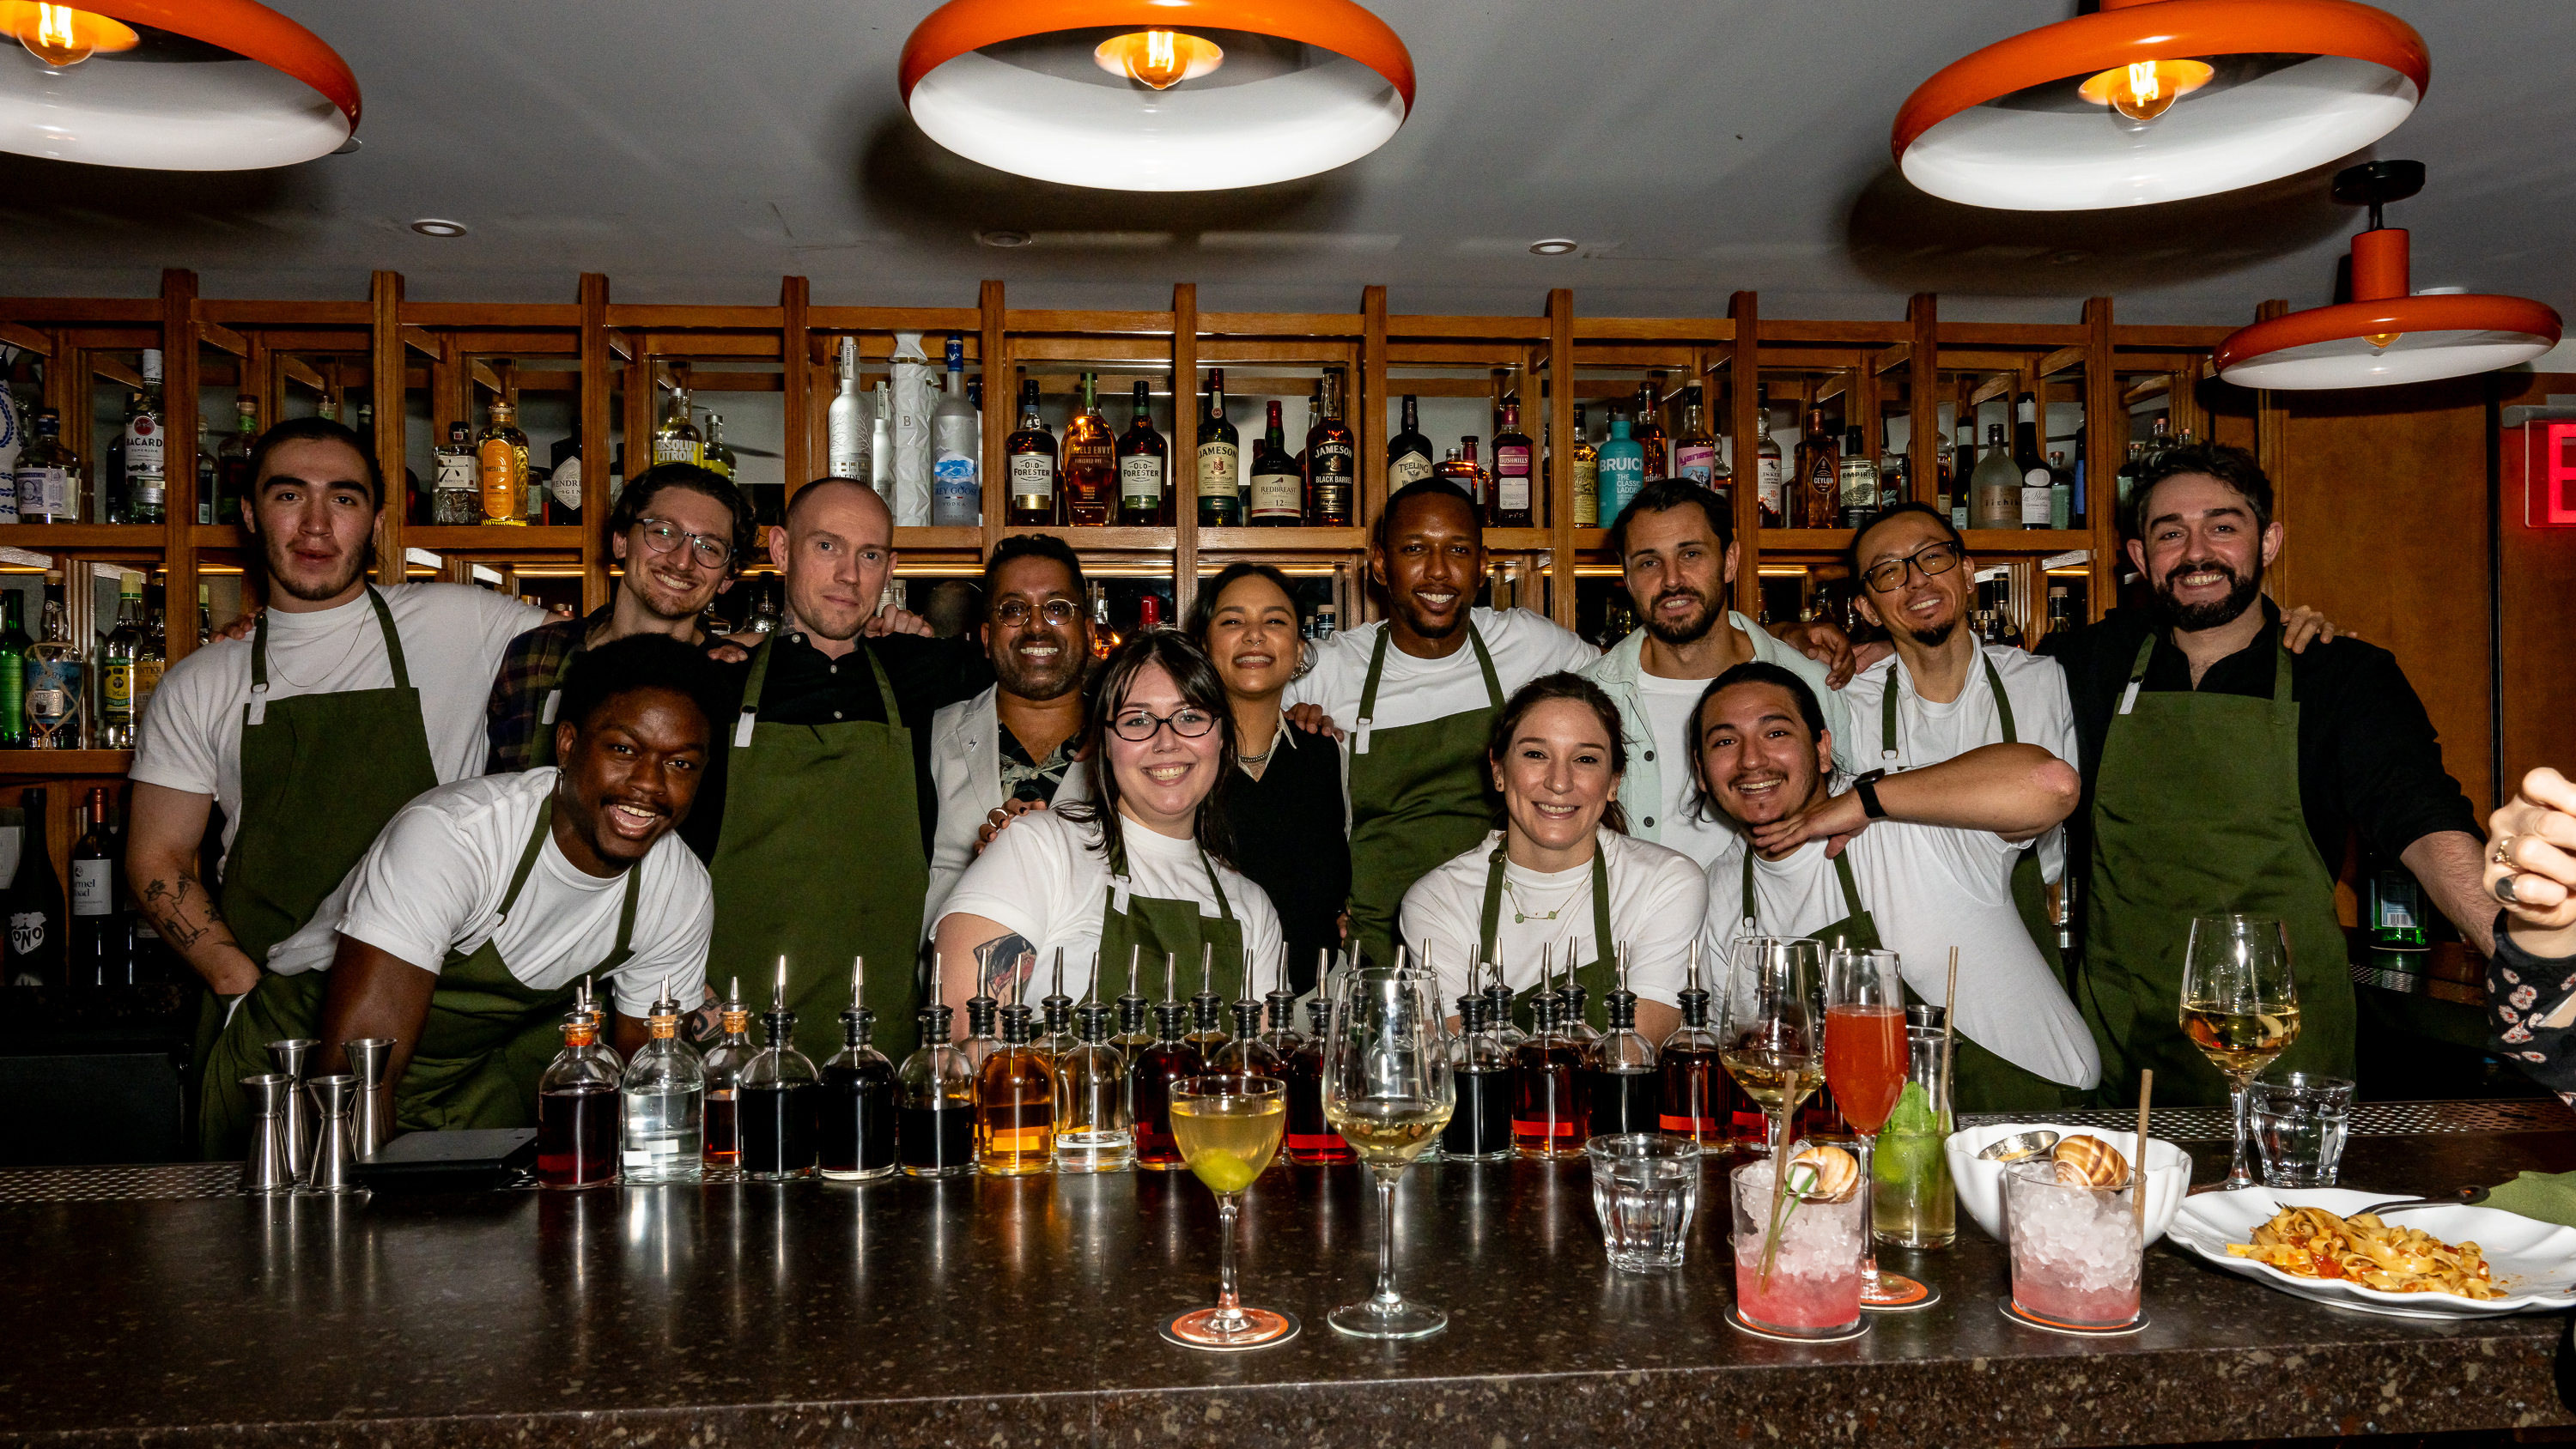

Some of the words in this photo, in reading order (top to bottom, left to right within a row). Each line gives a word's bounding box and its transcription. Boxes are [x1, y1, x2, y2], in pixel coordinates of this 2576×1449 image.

[903, 415, 911, 427] B
[126, 438, 163, 447] BACARD
[655, 439, 698, 452] ABSOLUT
[658, 451, 695, 462] CITRON
[1198, 446, 1236, 459] JAMESON
[1315, 446, 1353, 458] JAMESON
[1680, 451, 1714, 465] lyaness
[1398, 462, 1429, 473] TEELING
[1599, 457, 1644, 472] BRUICH
[1014, 468, 1051, 476] FORESTER
[1123, 469, 1159, 477] FORESTER
[551, 480, 581, 488] HENDRI
[1334, 476, 1352, 485] BARREL
[934, 487, 949, 495] REY
[951, 487, 978, 496] GOOSE
[1771, 489, 1777, 498] 10
[1985, 499, 2022, 507] iichik
[74, 878, 95, 888] rmel
